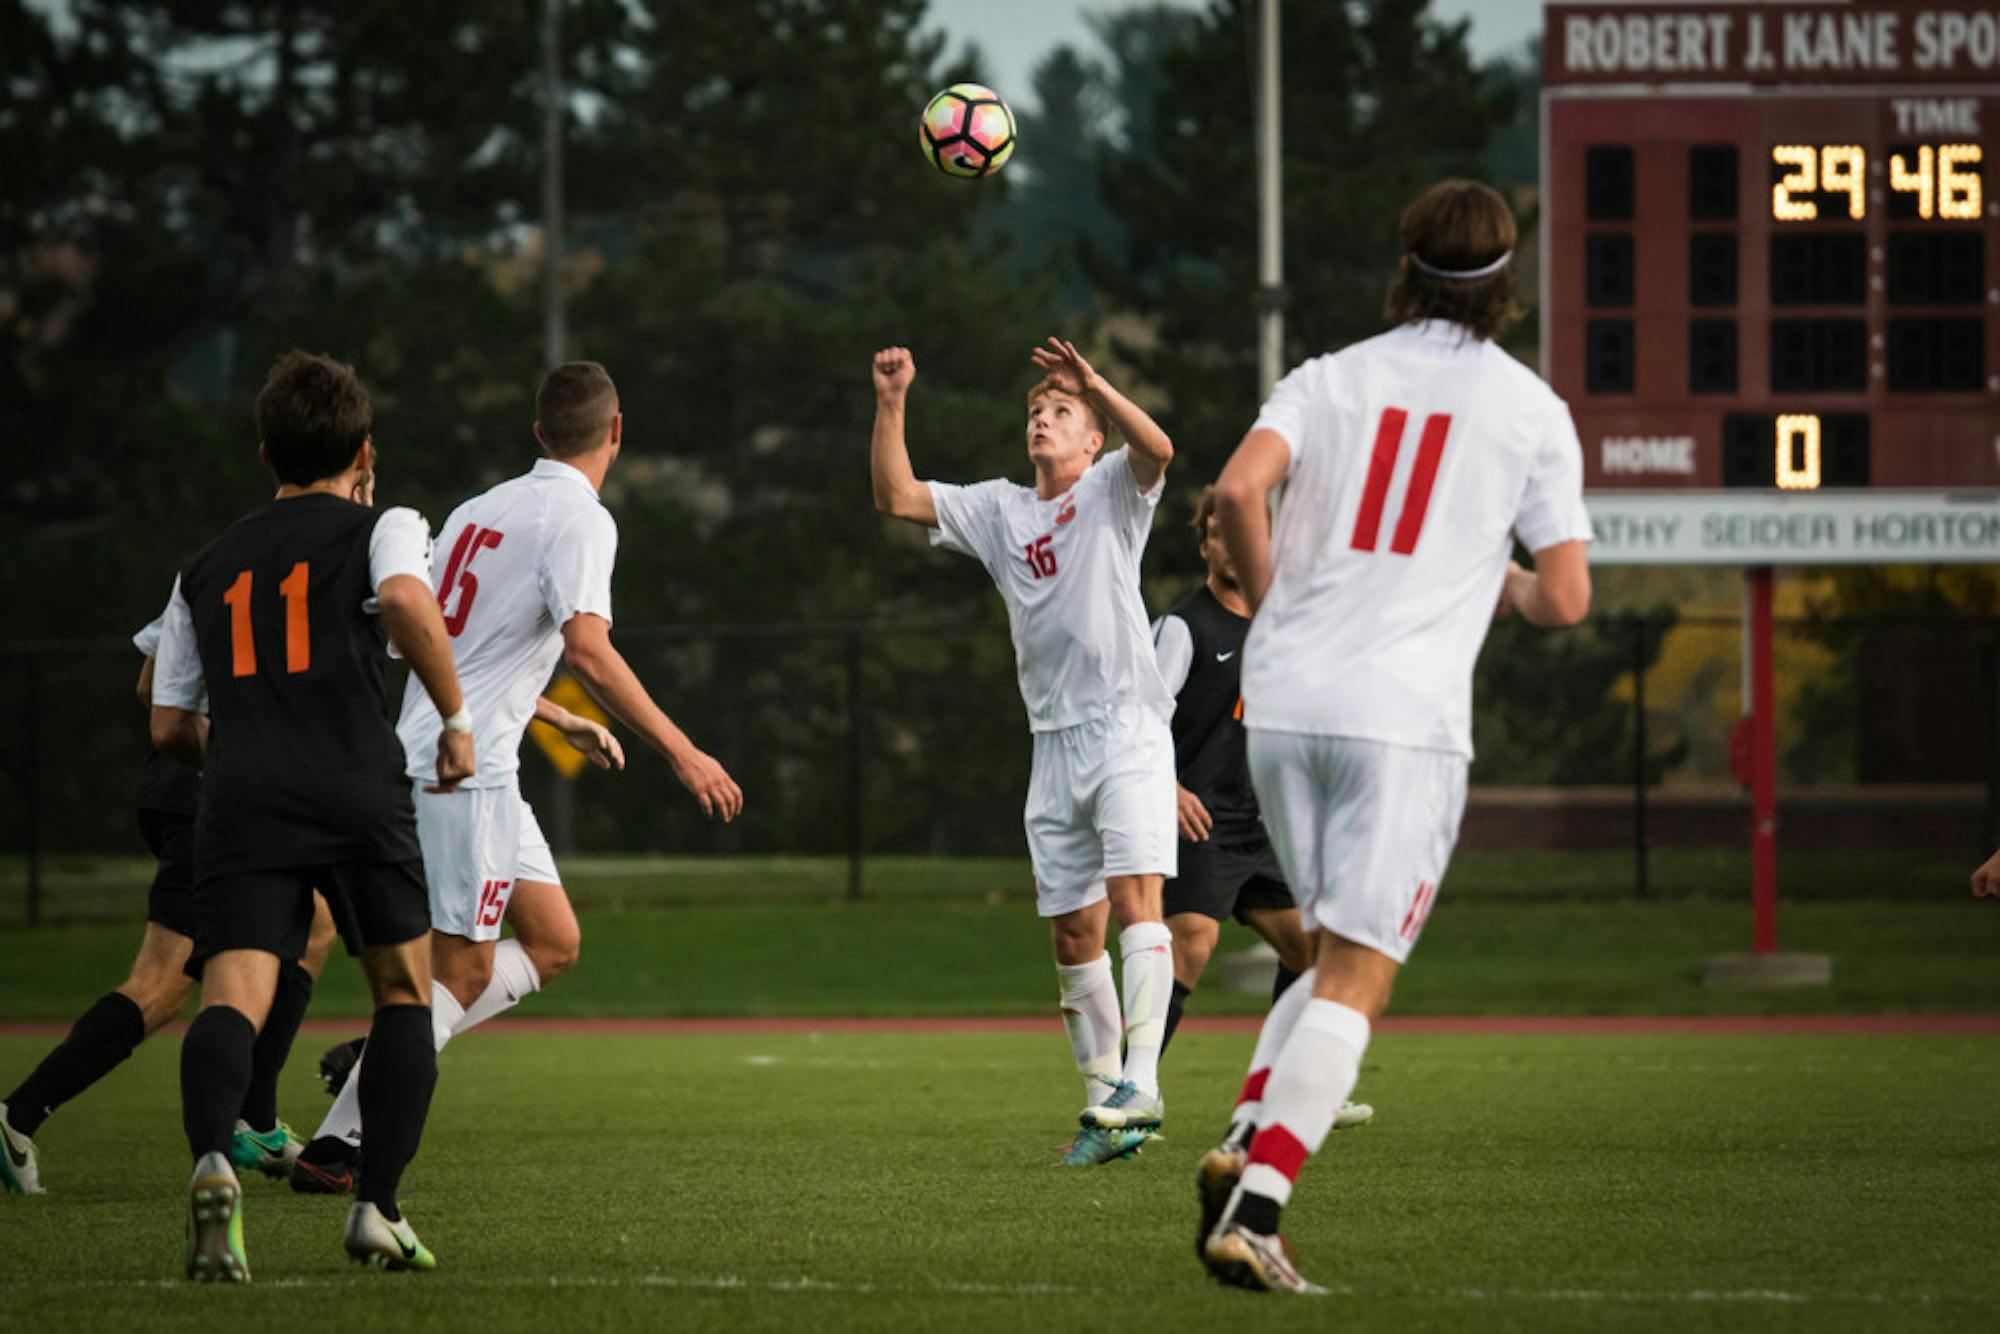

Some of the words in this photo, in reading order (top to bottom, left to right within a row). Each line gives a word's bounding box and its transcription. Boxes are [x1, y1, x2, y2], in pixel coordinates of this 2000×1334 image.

[1564, 14, 1731, 70] ROBERT
[1745, 14, 1774, 70] J.
[1783, 13, 1899, 67] KANE
[1913, 11, 2000, 68] SPO
[1893, 101, 1978, 132] TIME
[1773, 145, 1866, 220] 29
[1890, 144, 1982, 220] 46
[1602, 437, 1696, 474] HOME
[1775, 414, 1822, 489] 0
[1350, 406, 1452, 555] 11
[1025, 534, 1057, 579] 16
[1702, 513, 1837, 548] SEIDER
[223, 561, 310, 678] 11
[476, 880, 510, 926] 15
